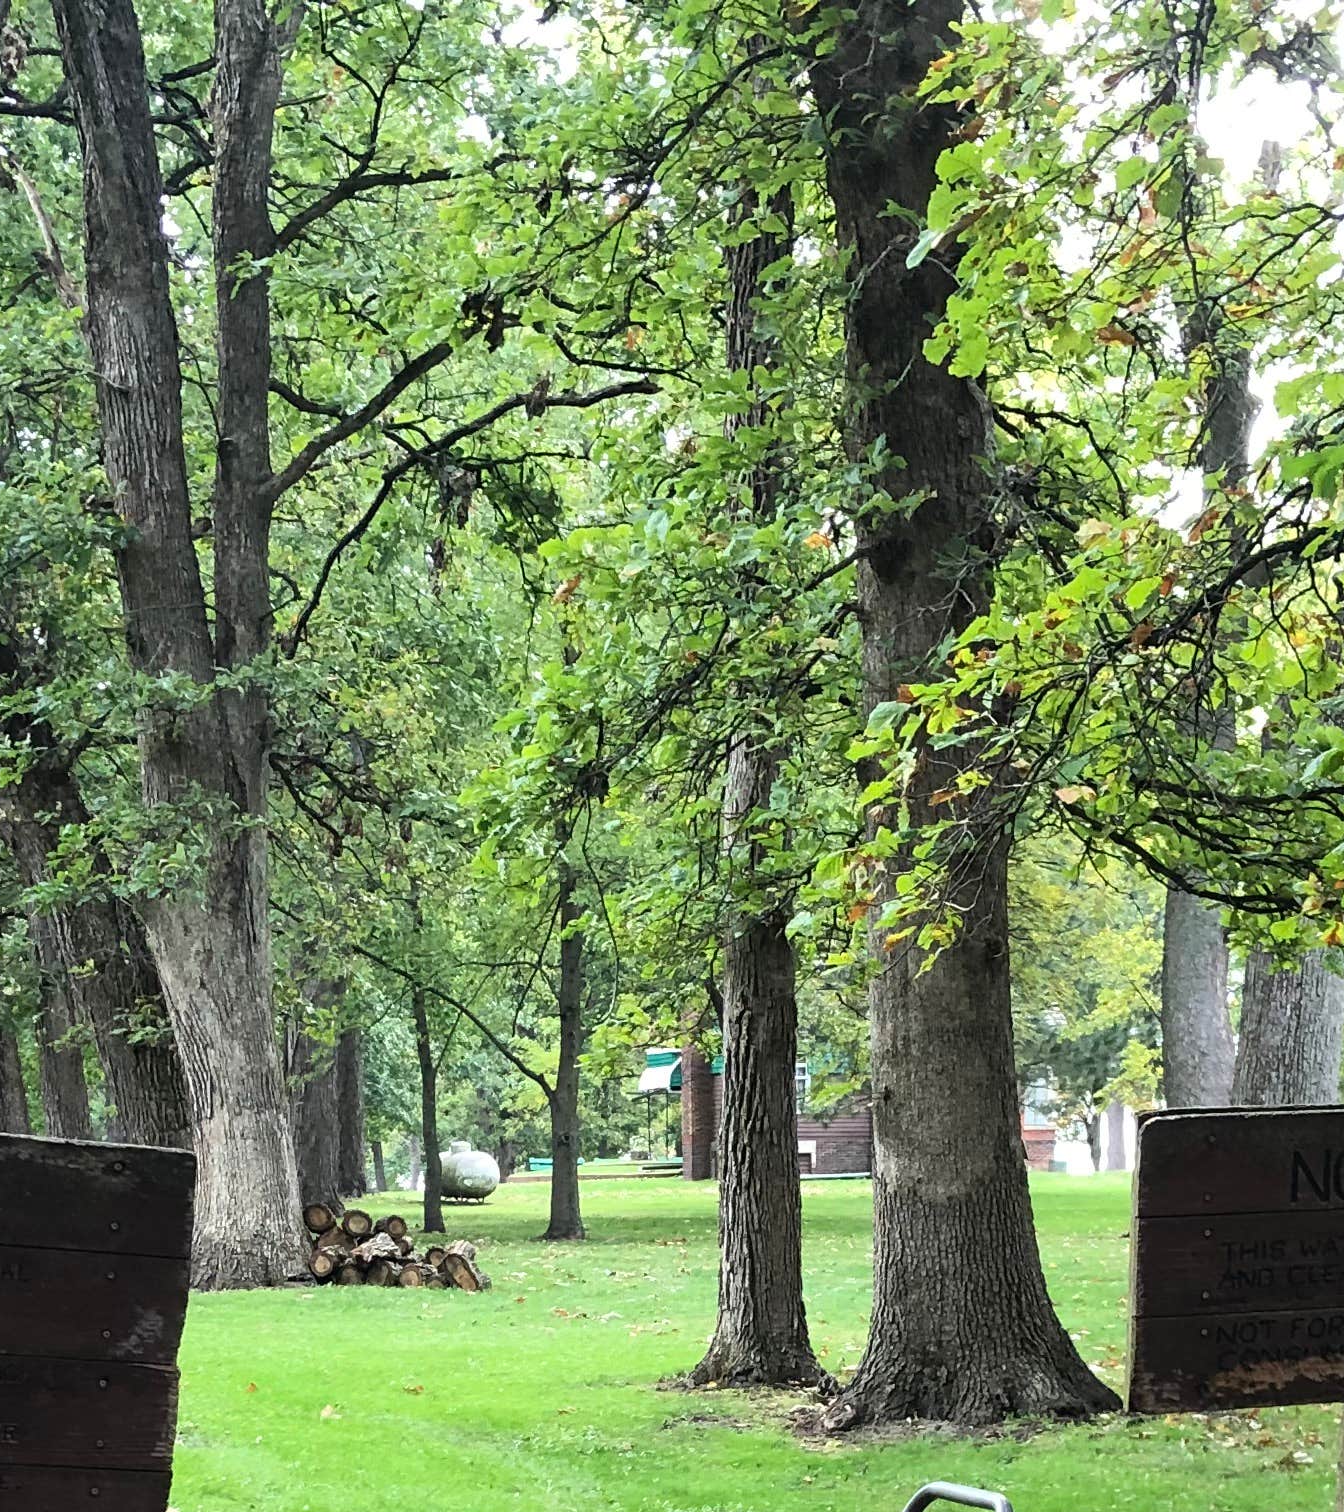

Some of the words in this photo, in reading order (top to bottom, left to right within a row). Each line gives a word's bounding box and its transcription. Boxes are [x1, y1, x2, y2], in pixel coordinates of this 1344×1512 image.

[1220, 1238, 1285, 1263] THIS
[1217, 1265, 1274, 1290] AND
[1216, 1319, 1276, 1345] NOT
[1291, 1314, 1344, 1340] FOR
